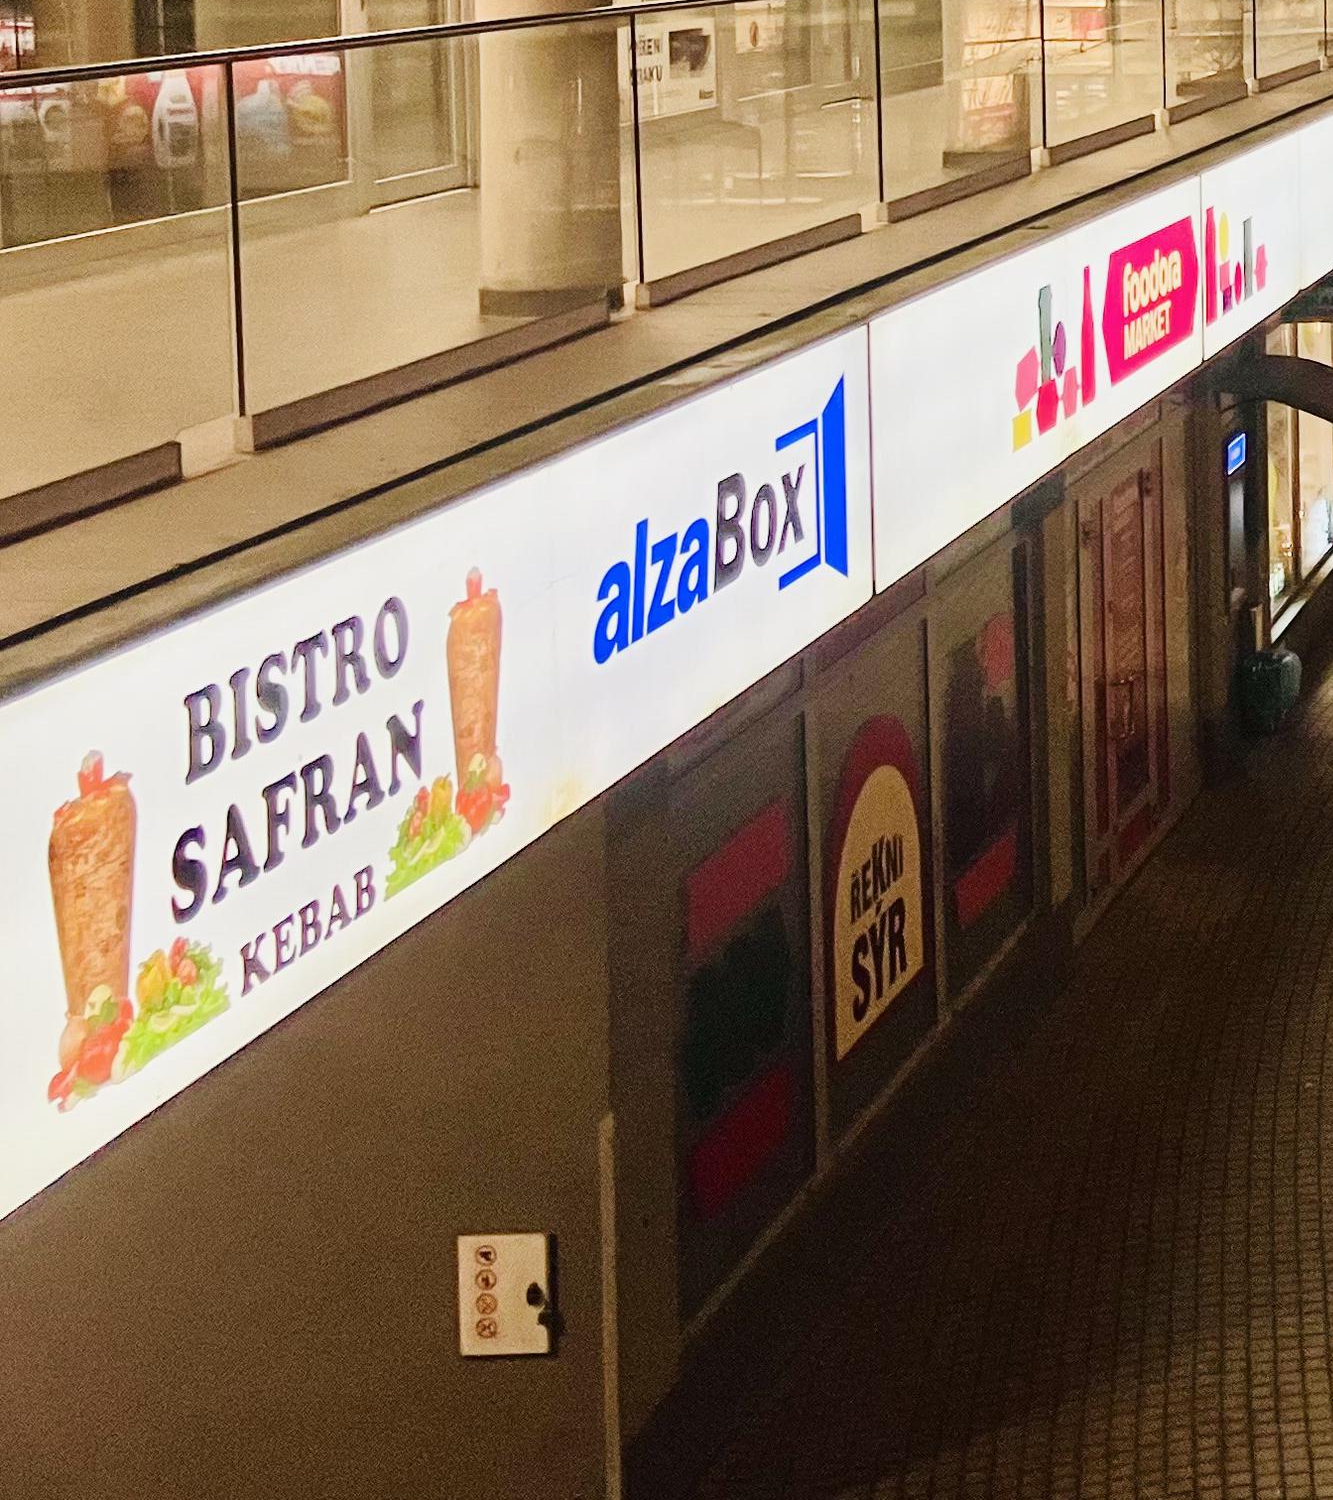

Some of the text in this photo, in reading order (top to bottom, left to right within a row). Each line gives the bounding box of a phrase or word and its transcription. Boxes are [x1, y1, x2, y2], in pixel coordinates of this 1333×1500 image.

[1122, 248, 1183, 319] foodora
[1123, 299, 1173, 361] MARKET
[183, 594, 410, 788] BISTRO
[170, 698, 429, 926] SAFRAN
[239, 862, 379, 999] KEBAB
[850, 832, 904, 925] ŘEKNI
[851, 896, 908, 1023] SÝR
